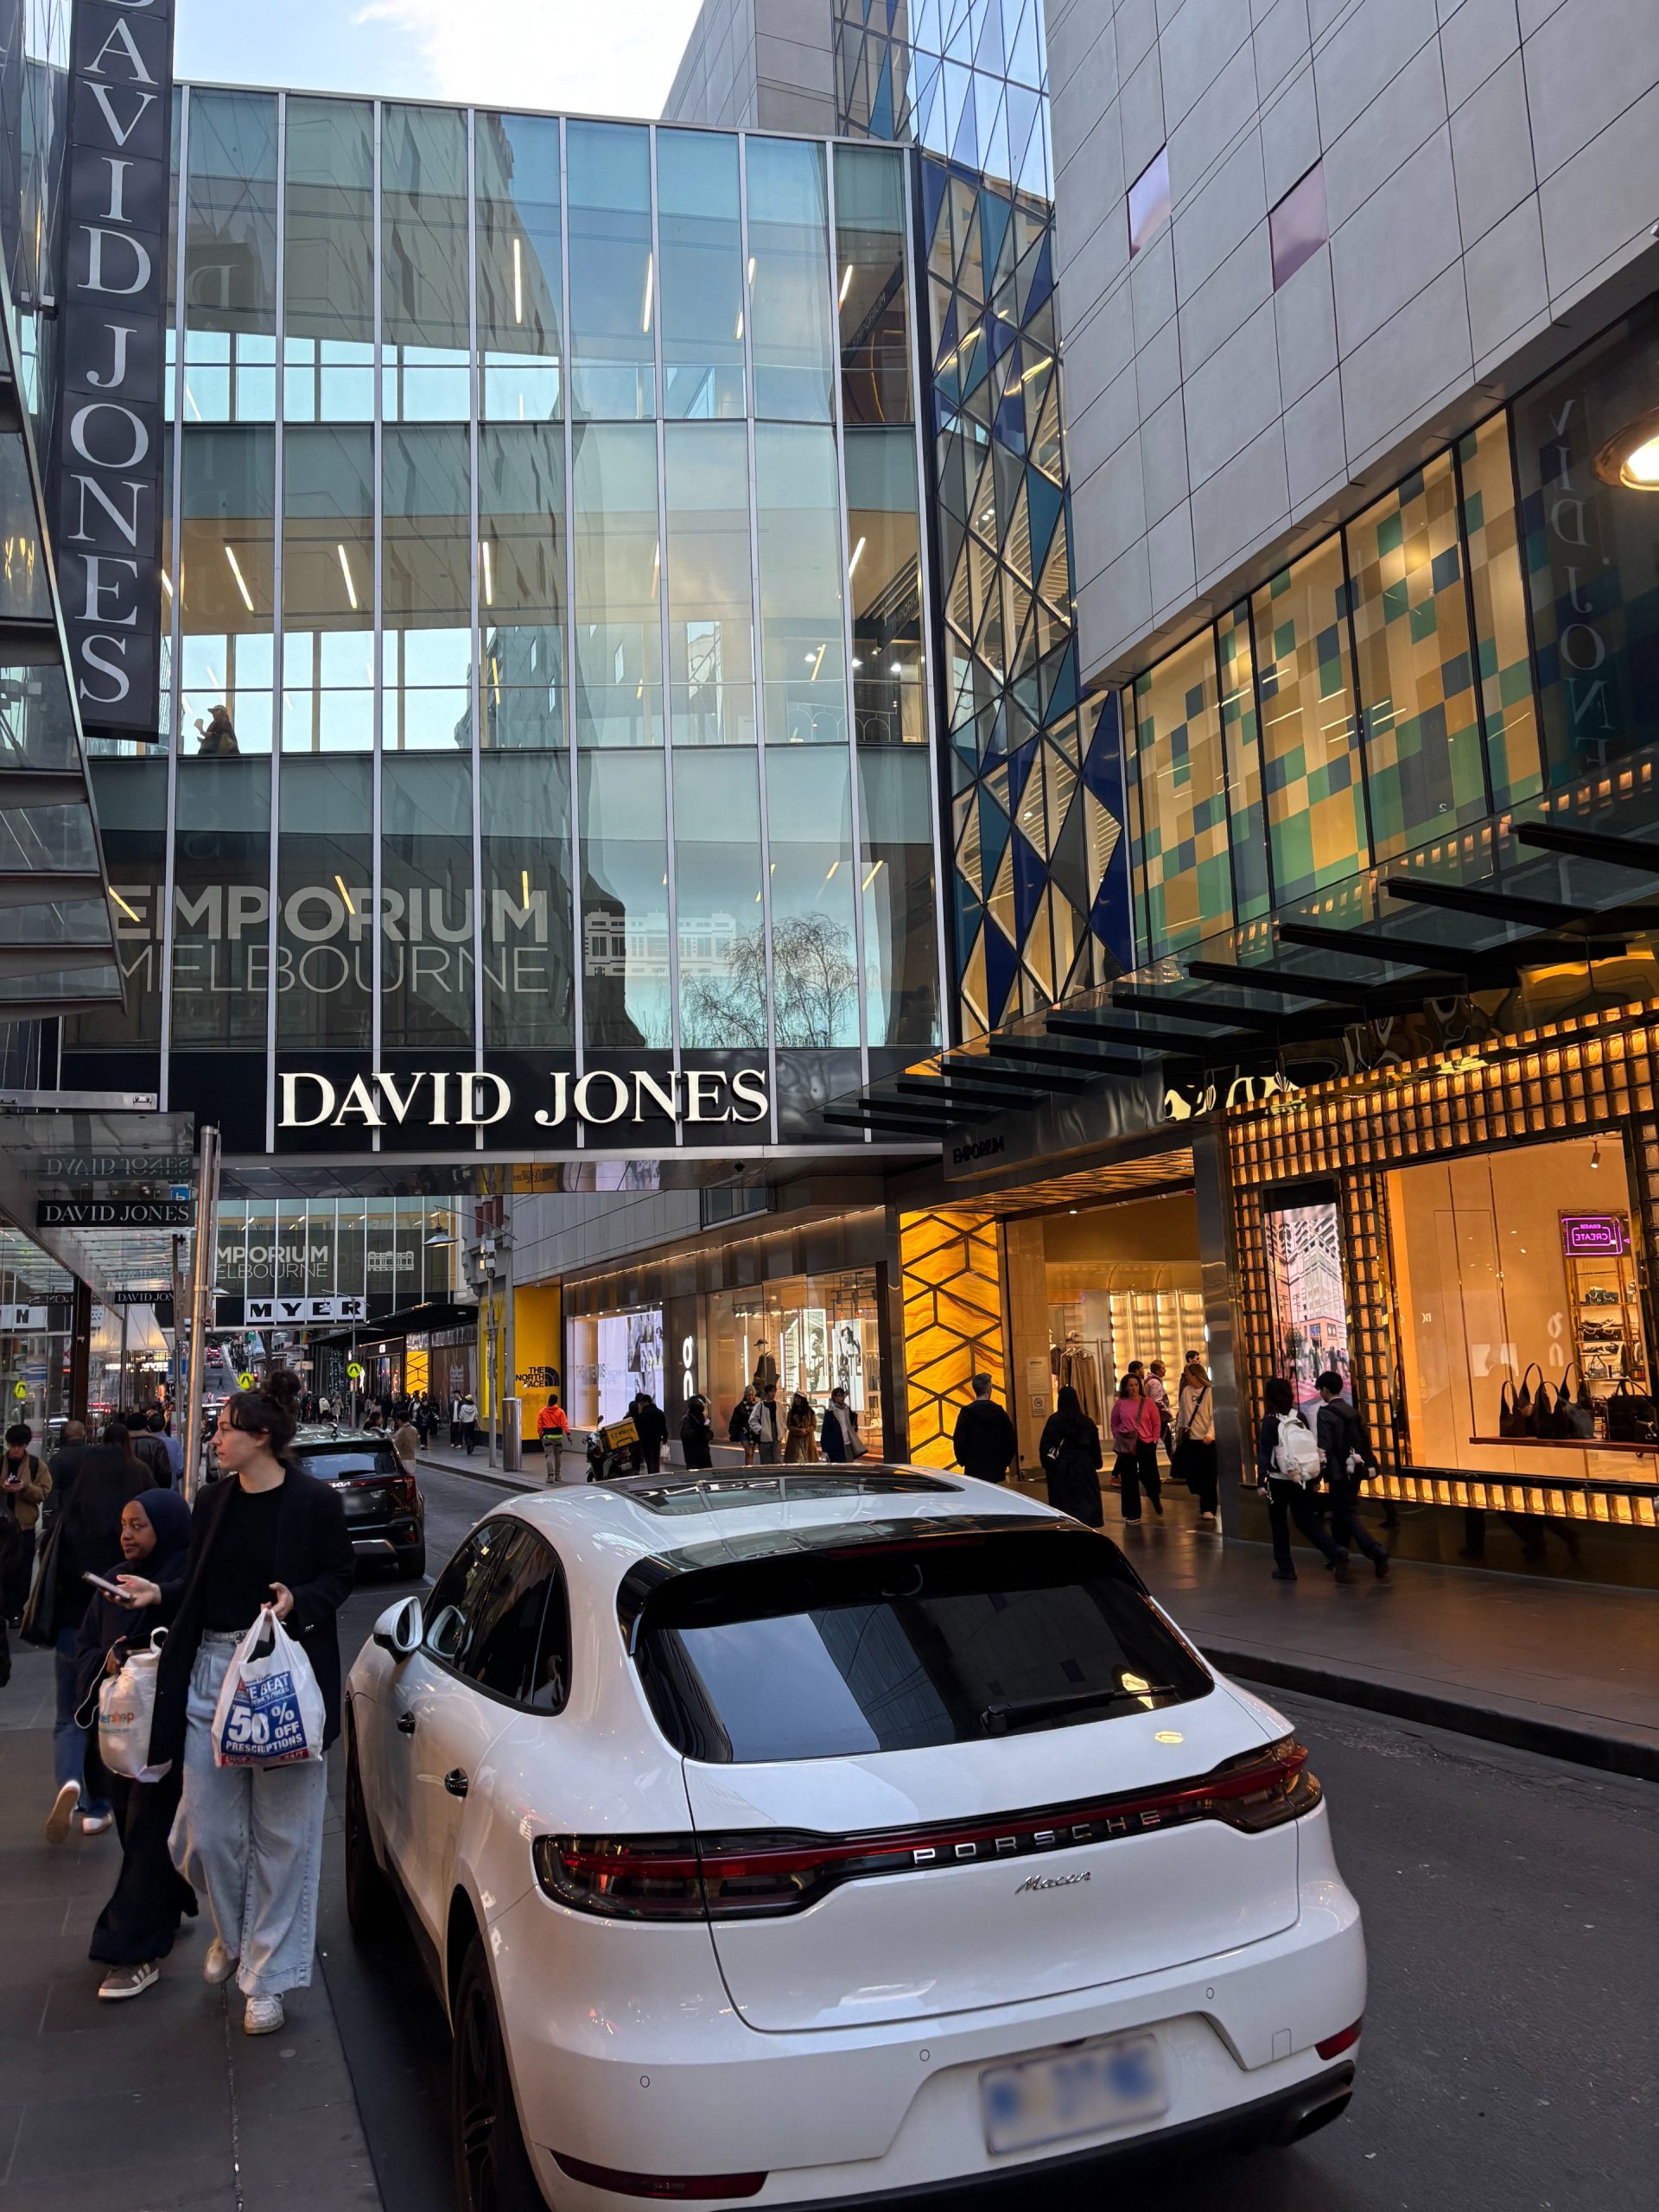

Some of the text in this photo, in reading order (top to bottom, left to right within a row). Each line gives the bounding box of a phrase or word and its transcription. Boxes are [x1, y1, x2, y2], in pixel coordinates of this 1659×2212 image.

[67, 0, 158, 704] AVID JONES
[115, 885, 550, 943] EMPORIUM
[277, 1069, 769, 1128] DAVID JONES
[953, 1135, 1004, 1165] EMPORIUM
[44, 1205, 189, 1222] DAVID JONES
[217, 1245, 328, 1263] MPORIUM
[216, 1263, 328, 1279] ELBOURNE
[118, 1293, 152, 1302] DAVID
[250, 1300, 361, 1318] MYER
[260, 1674, 289, 1697] BEAT
[274, 1721, 300, 1739] OFF
[226, 1733, 303, 1753] PRESCRIPTIONS
[913, 1809, 1160, 1864] PORSCHE
[1014, 1869, 1091, 1894] Macan
